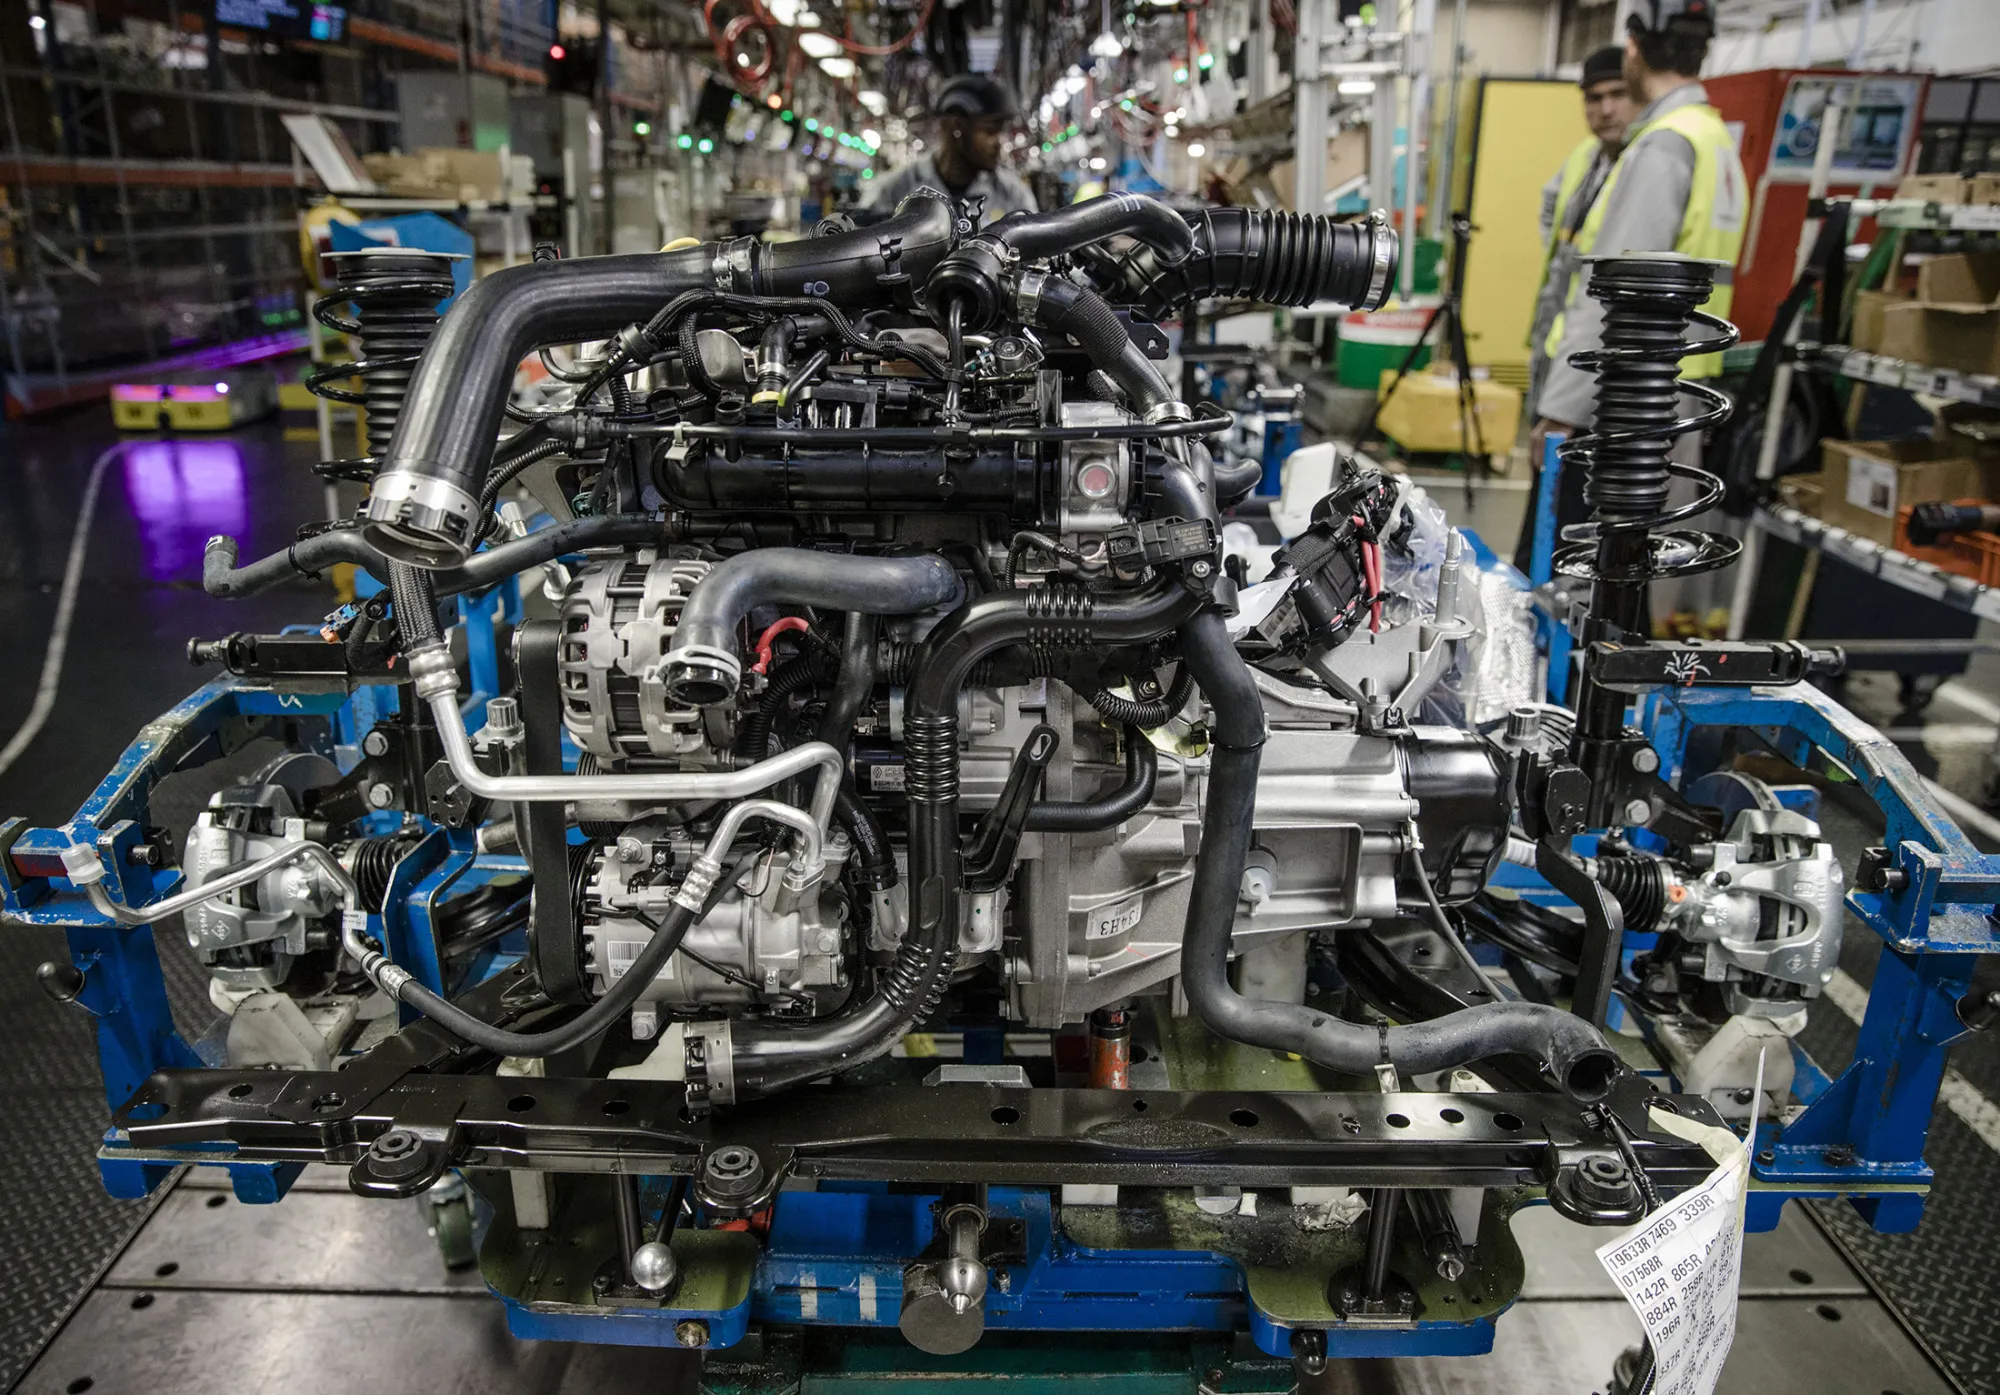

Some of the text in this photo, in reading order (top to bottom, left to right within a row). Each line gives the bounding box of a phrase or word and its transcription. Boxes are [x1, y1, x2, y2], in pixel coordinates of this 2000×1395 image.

[1609, 1237, 1651, 1270] 19633R
[1648, 1218, 1677, 1245] 7469
[1622, 1255, 1663, 1288] 07568R
[1637, 1277, 1669, 1306] 142R
[1671, 1253, 1703, 1282] 865R
[1646, 1296, 1678, 1326] 884R
[1655, 1315, 1680, 1344] 196R
